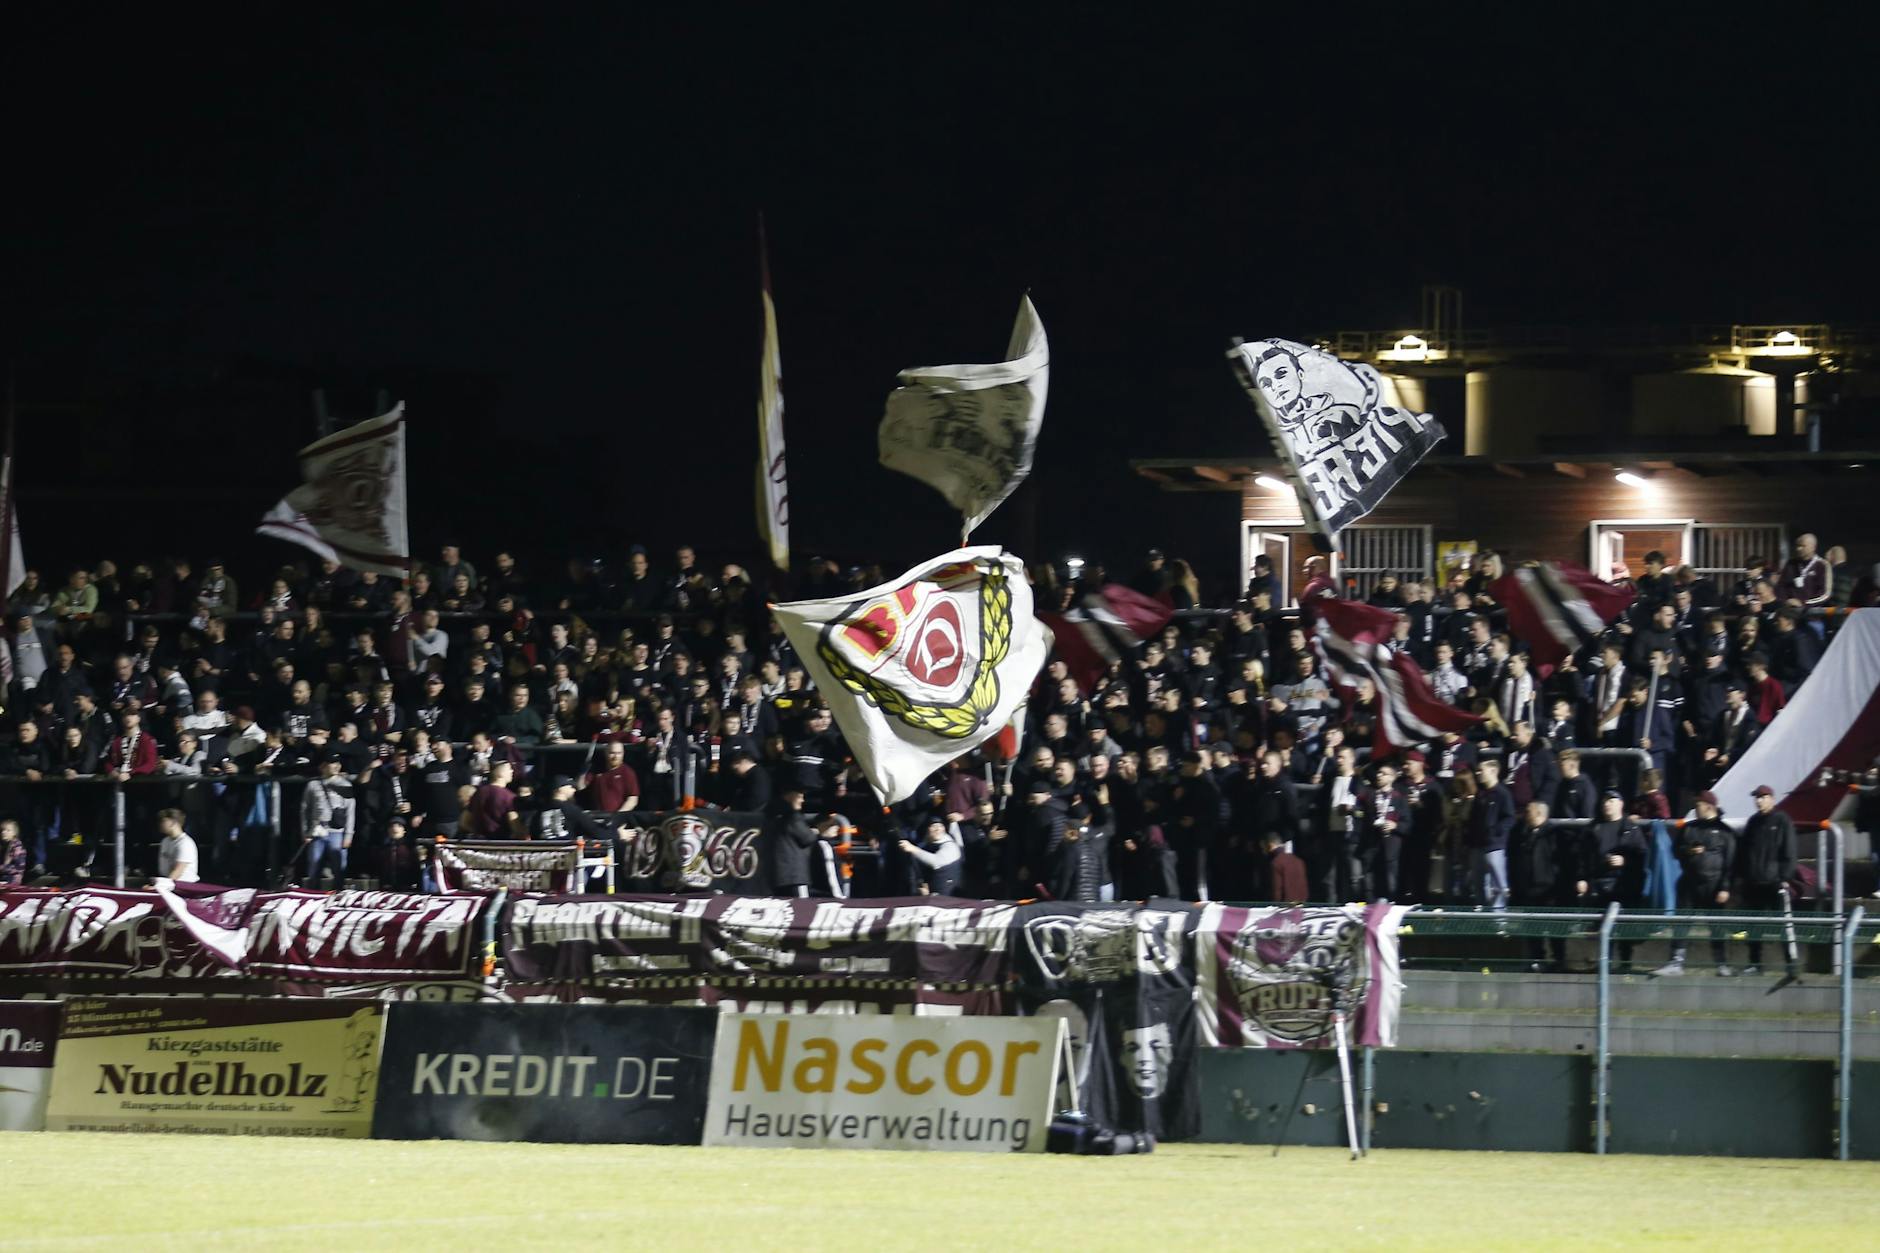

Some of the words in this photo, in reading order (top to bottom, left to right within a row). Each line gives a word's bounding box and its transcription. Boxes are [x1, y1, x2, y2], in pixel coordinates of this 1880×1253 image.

[704, 826, 761, 878] 66
[147, 1036, 283, 1057] Kiezgaststätte
[731, 1019, 1041, 1097] Nascor
[94, 1061, 328, 1098] Nudelholz
[411, 1053, 680, 1100] KREDIT.DE
[723, 1104, 1031, 1151] Hausverwaltung
